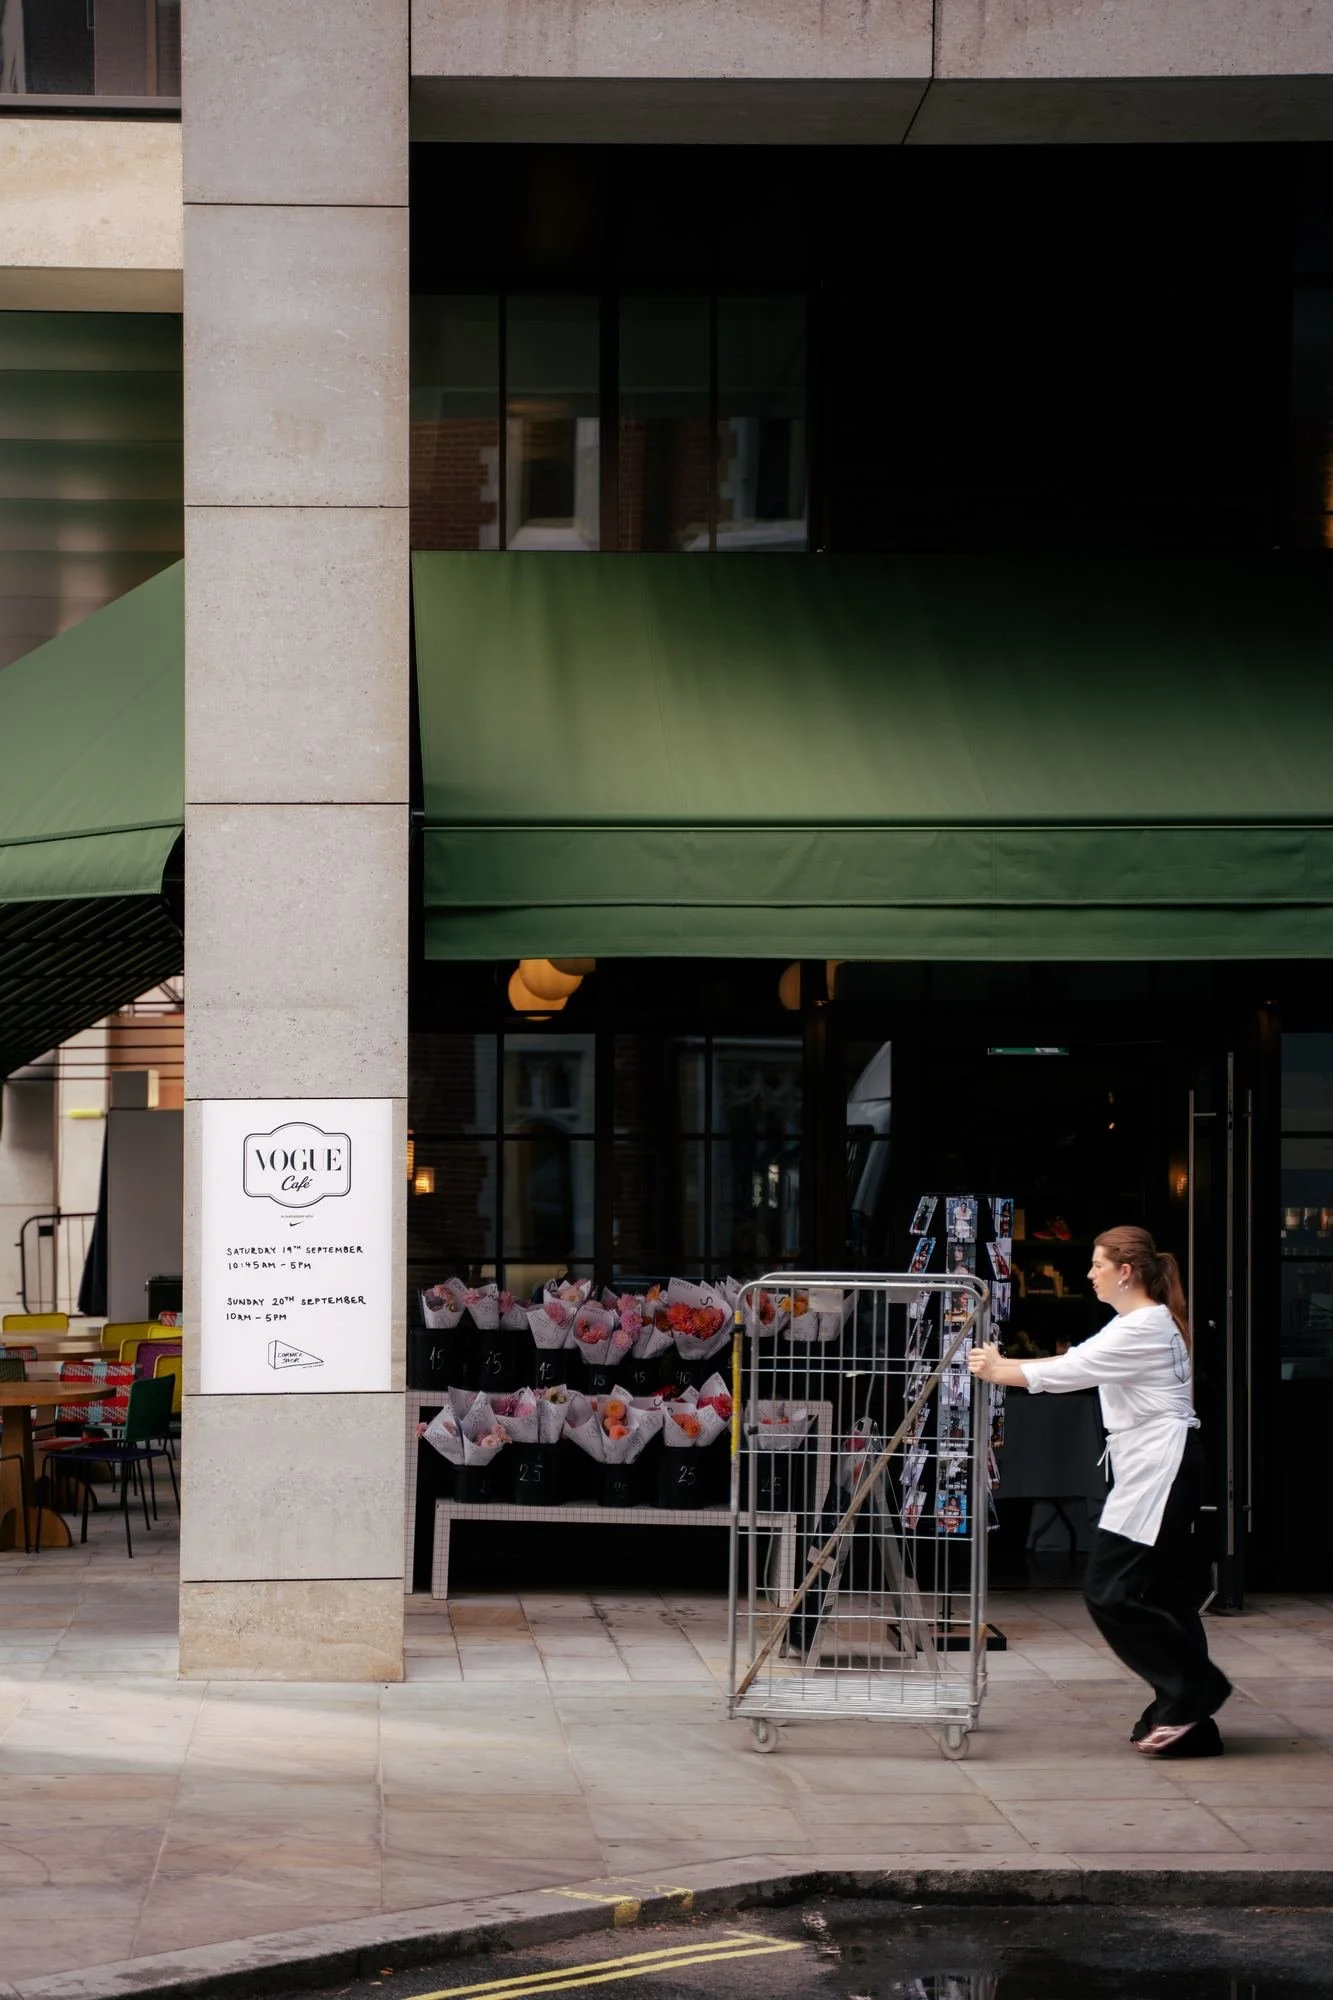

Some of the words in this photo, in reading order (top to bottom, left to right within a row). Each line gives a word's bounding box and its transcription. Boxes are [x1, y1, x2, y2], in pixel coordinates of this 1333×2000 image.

[255, 1147, 342, 1172] VOGUE
[281, 1174, 313, 1192] Café
[226, 1246, 277, 1256] SATURDAY
[306, 1245, 364, 1254] SEPTEMBER
[290, 1261, 312, 1270] 5PM
[227, 1297, 265, 1306] SUNDAY
[271, 1296, 295, 1306] 20TH
[301, 1295, 367, 1306] SEPTEMBER
[226, 1312, 252, 1321] 10AM
[265, 1313, 287, 1322] 5PM
[519, 1463, 545, 1482] 25
[677, 1465, 697, 1485] 25
